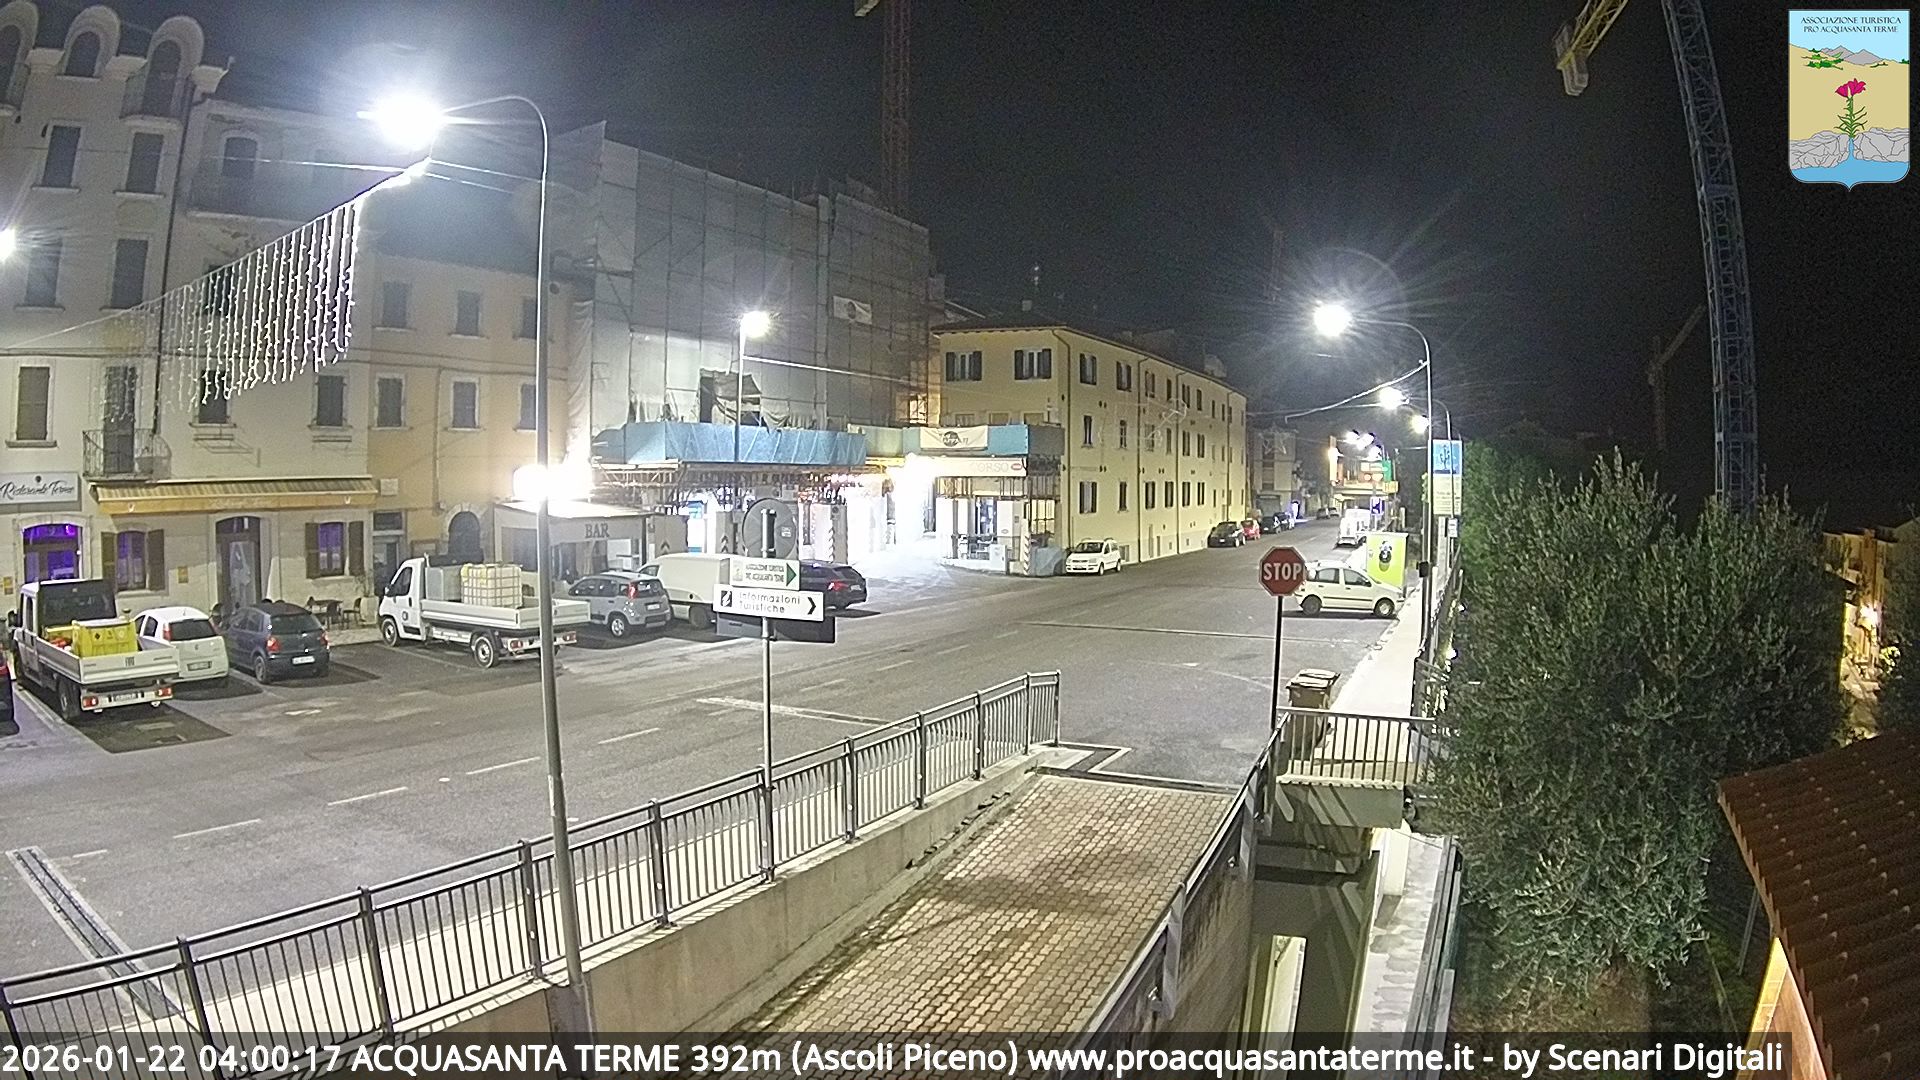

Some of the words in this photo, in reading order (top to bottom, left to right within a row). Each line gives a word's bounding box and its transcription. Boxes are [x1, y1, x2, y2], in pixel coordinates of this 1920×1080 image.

[585, 523, 610, 538] BAR
[1263, 563, 1302, 581] STOP
[739, 591, 801, 605] Informazioni
[739, 601, 785, 614] Turistiche
